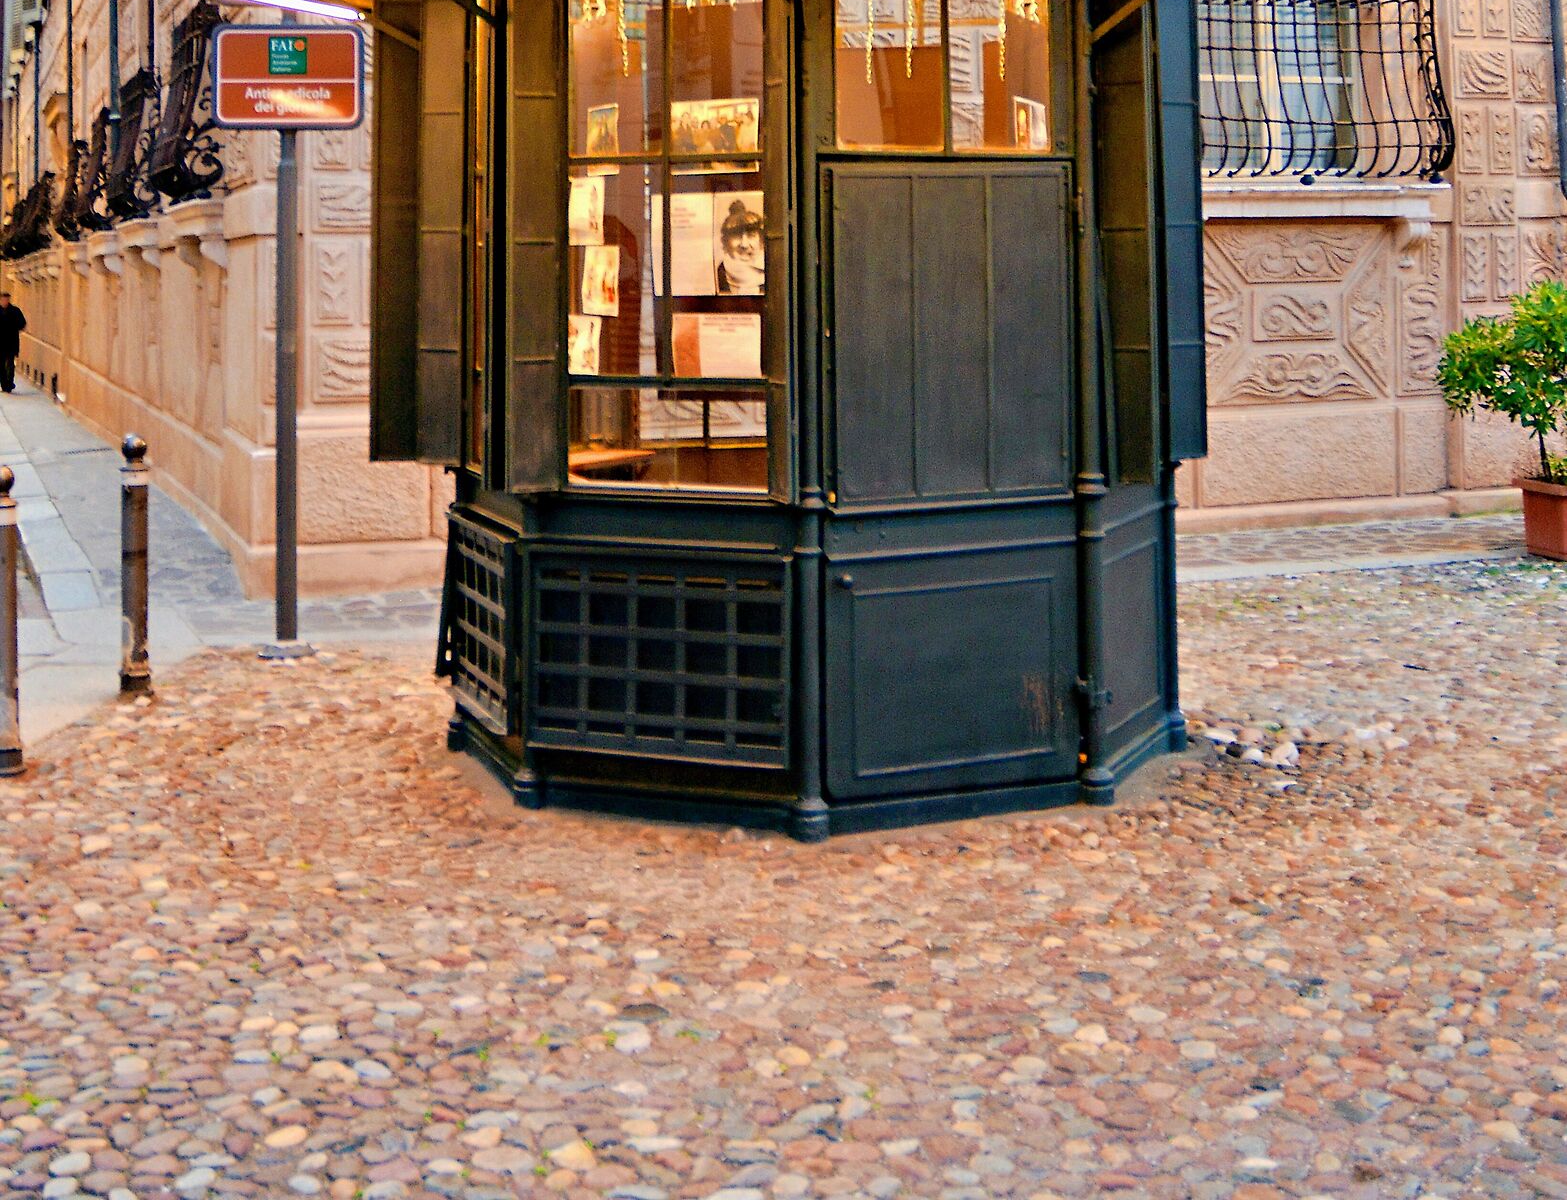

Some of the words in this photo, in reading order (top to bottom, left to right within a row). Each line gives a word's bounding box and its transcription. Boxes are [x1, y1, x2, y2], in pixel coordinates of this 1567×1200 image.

[271, 39, 294, 51] FAI
[245, 87, 283, 99] Anti
[254, 101, 274, 113] dei
[276, 101, 324, 116] giorn
